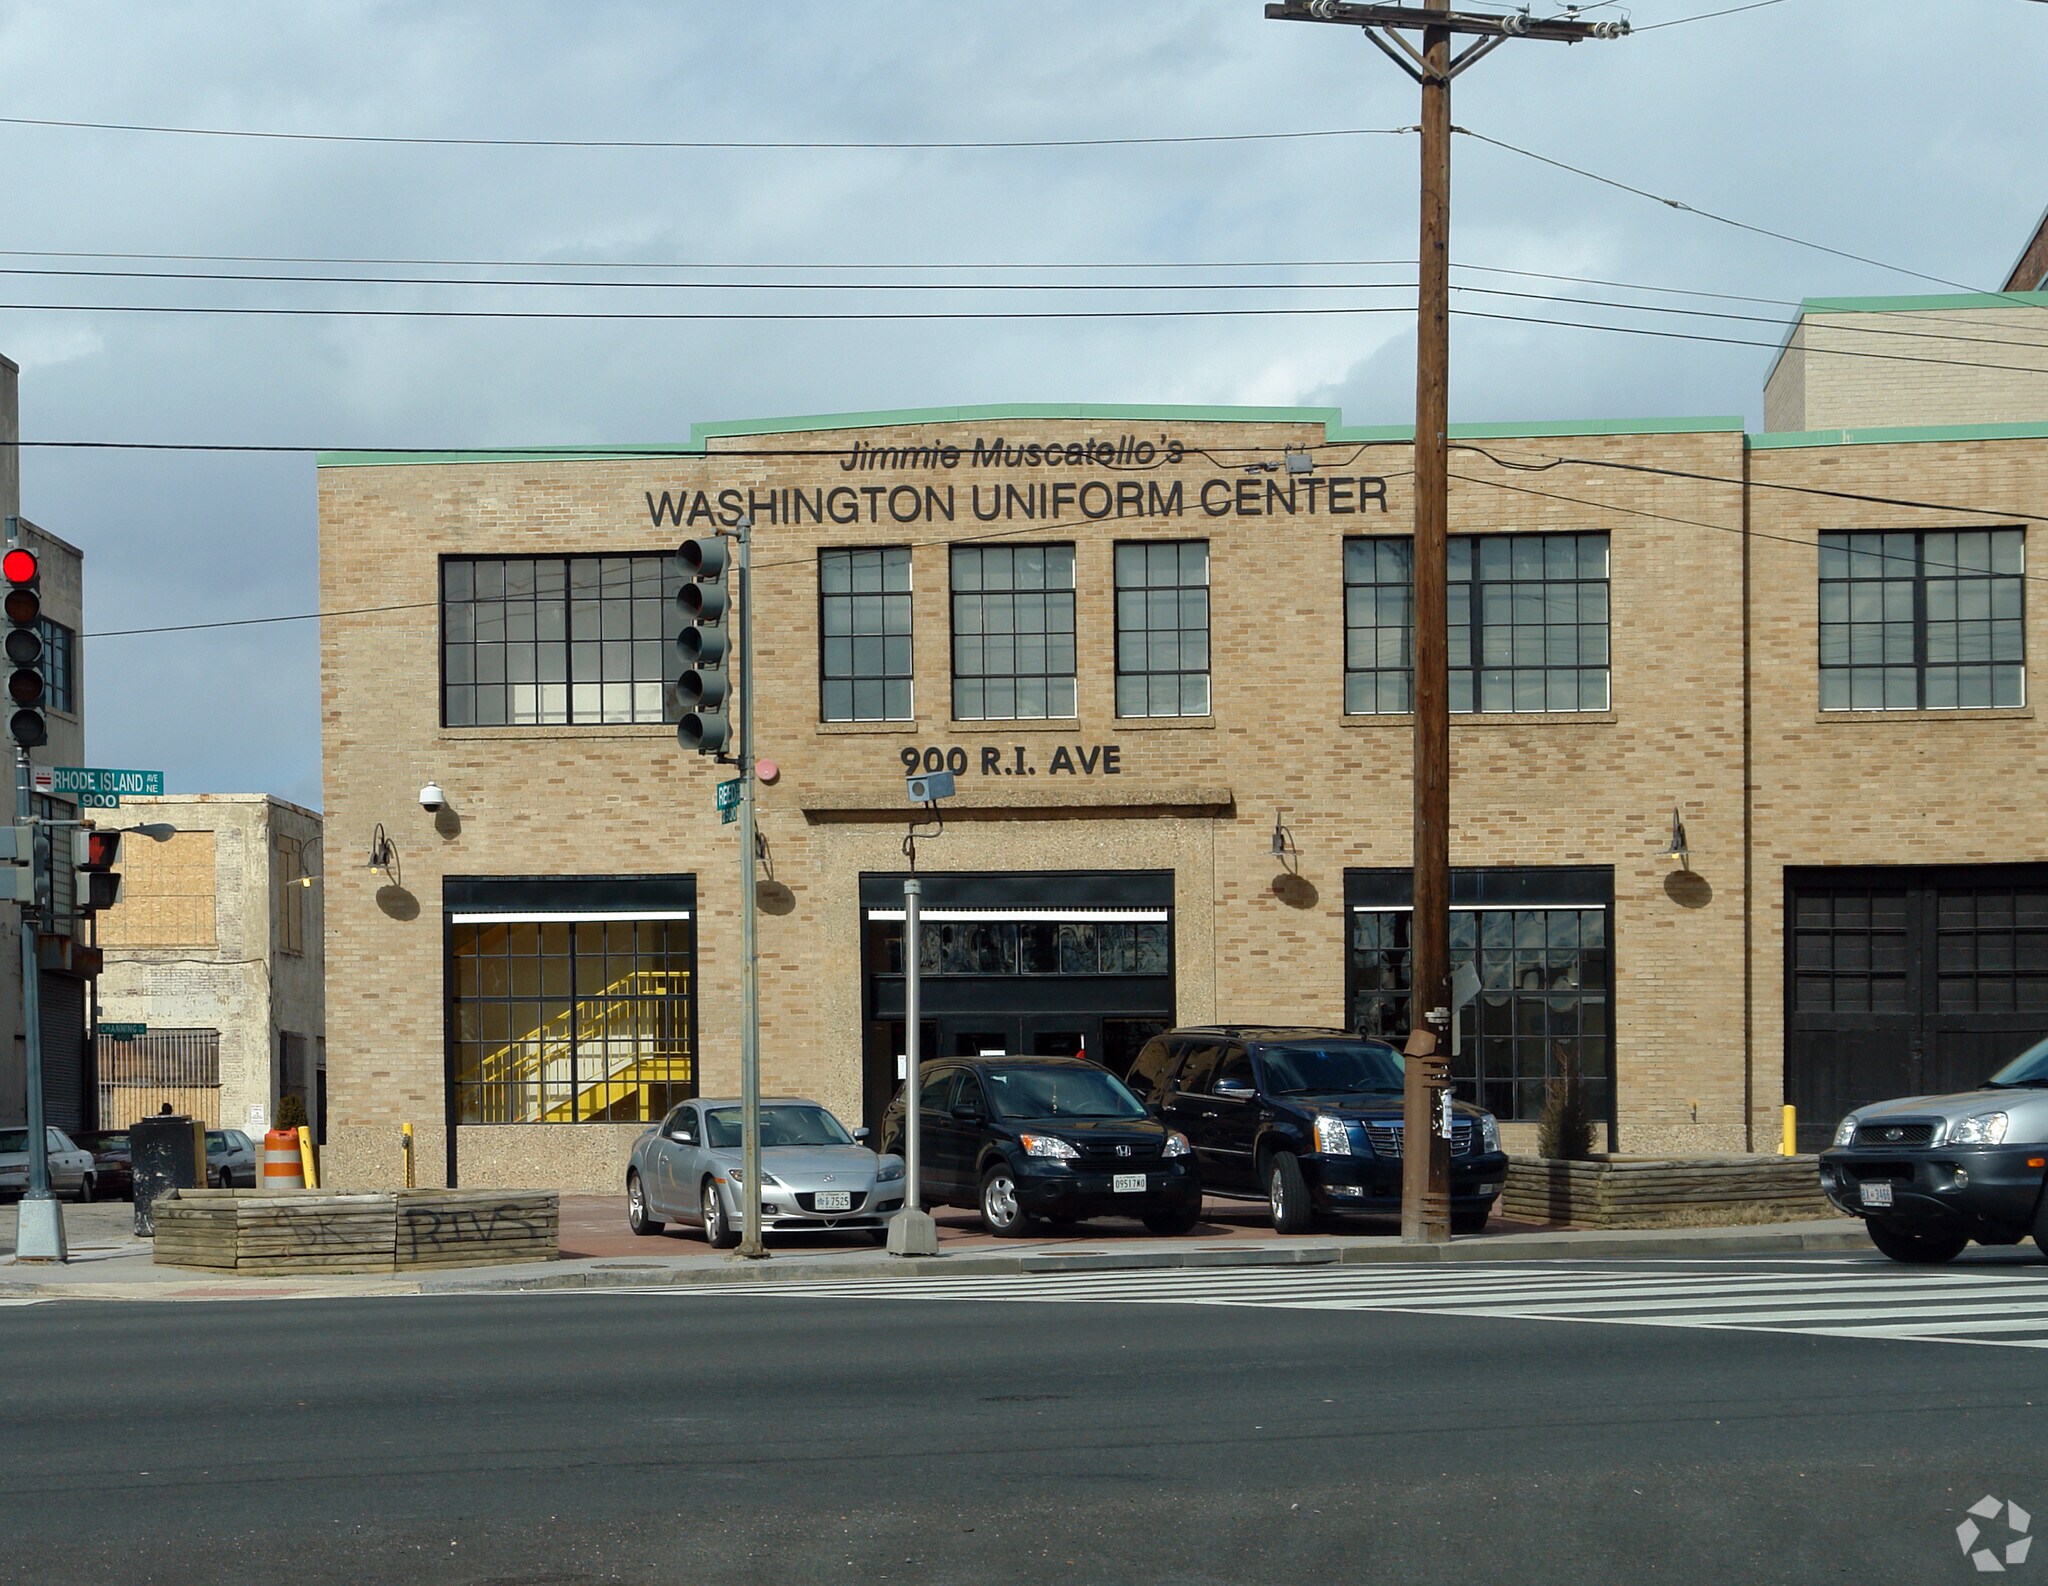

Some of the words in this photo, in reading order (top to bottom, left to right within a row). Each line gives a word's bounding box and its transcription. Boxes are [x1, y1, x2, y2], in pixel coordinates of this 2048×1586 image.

[840, 439, 961, 471] Jimmie
[971, 434, 1185, 468] Muscatello's
[646, 485, 955, 527] WASHINGTON
[972, 480, 1184, 521] UNIFORM
[1200, 477, 1389, 516] CENTER
[900, 746, 968, 776] 900
[981, 746, 1036, 775] R.I.
[1049, 745, 1121, 775] AVE
[54, 771, 95, 791] RHODE
[100, 772, 144, 792] ISLAND
[146, 773, 159, 783] AVE
[146, 784, 159, 793] NE
[82, 793, 117, 808] 900
[100, 1024, 137, 1034] CHANNING
